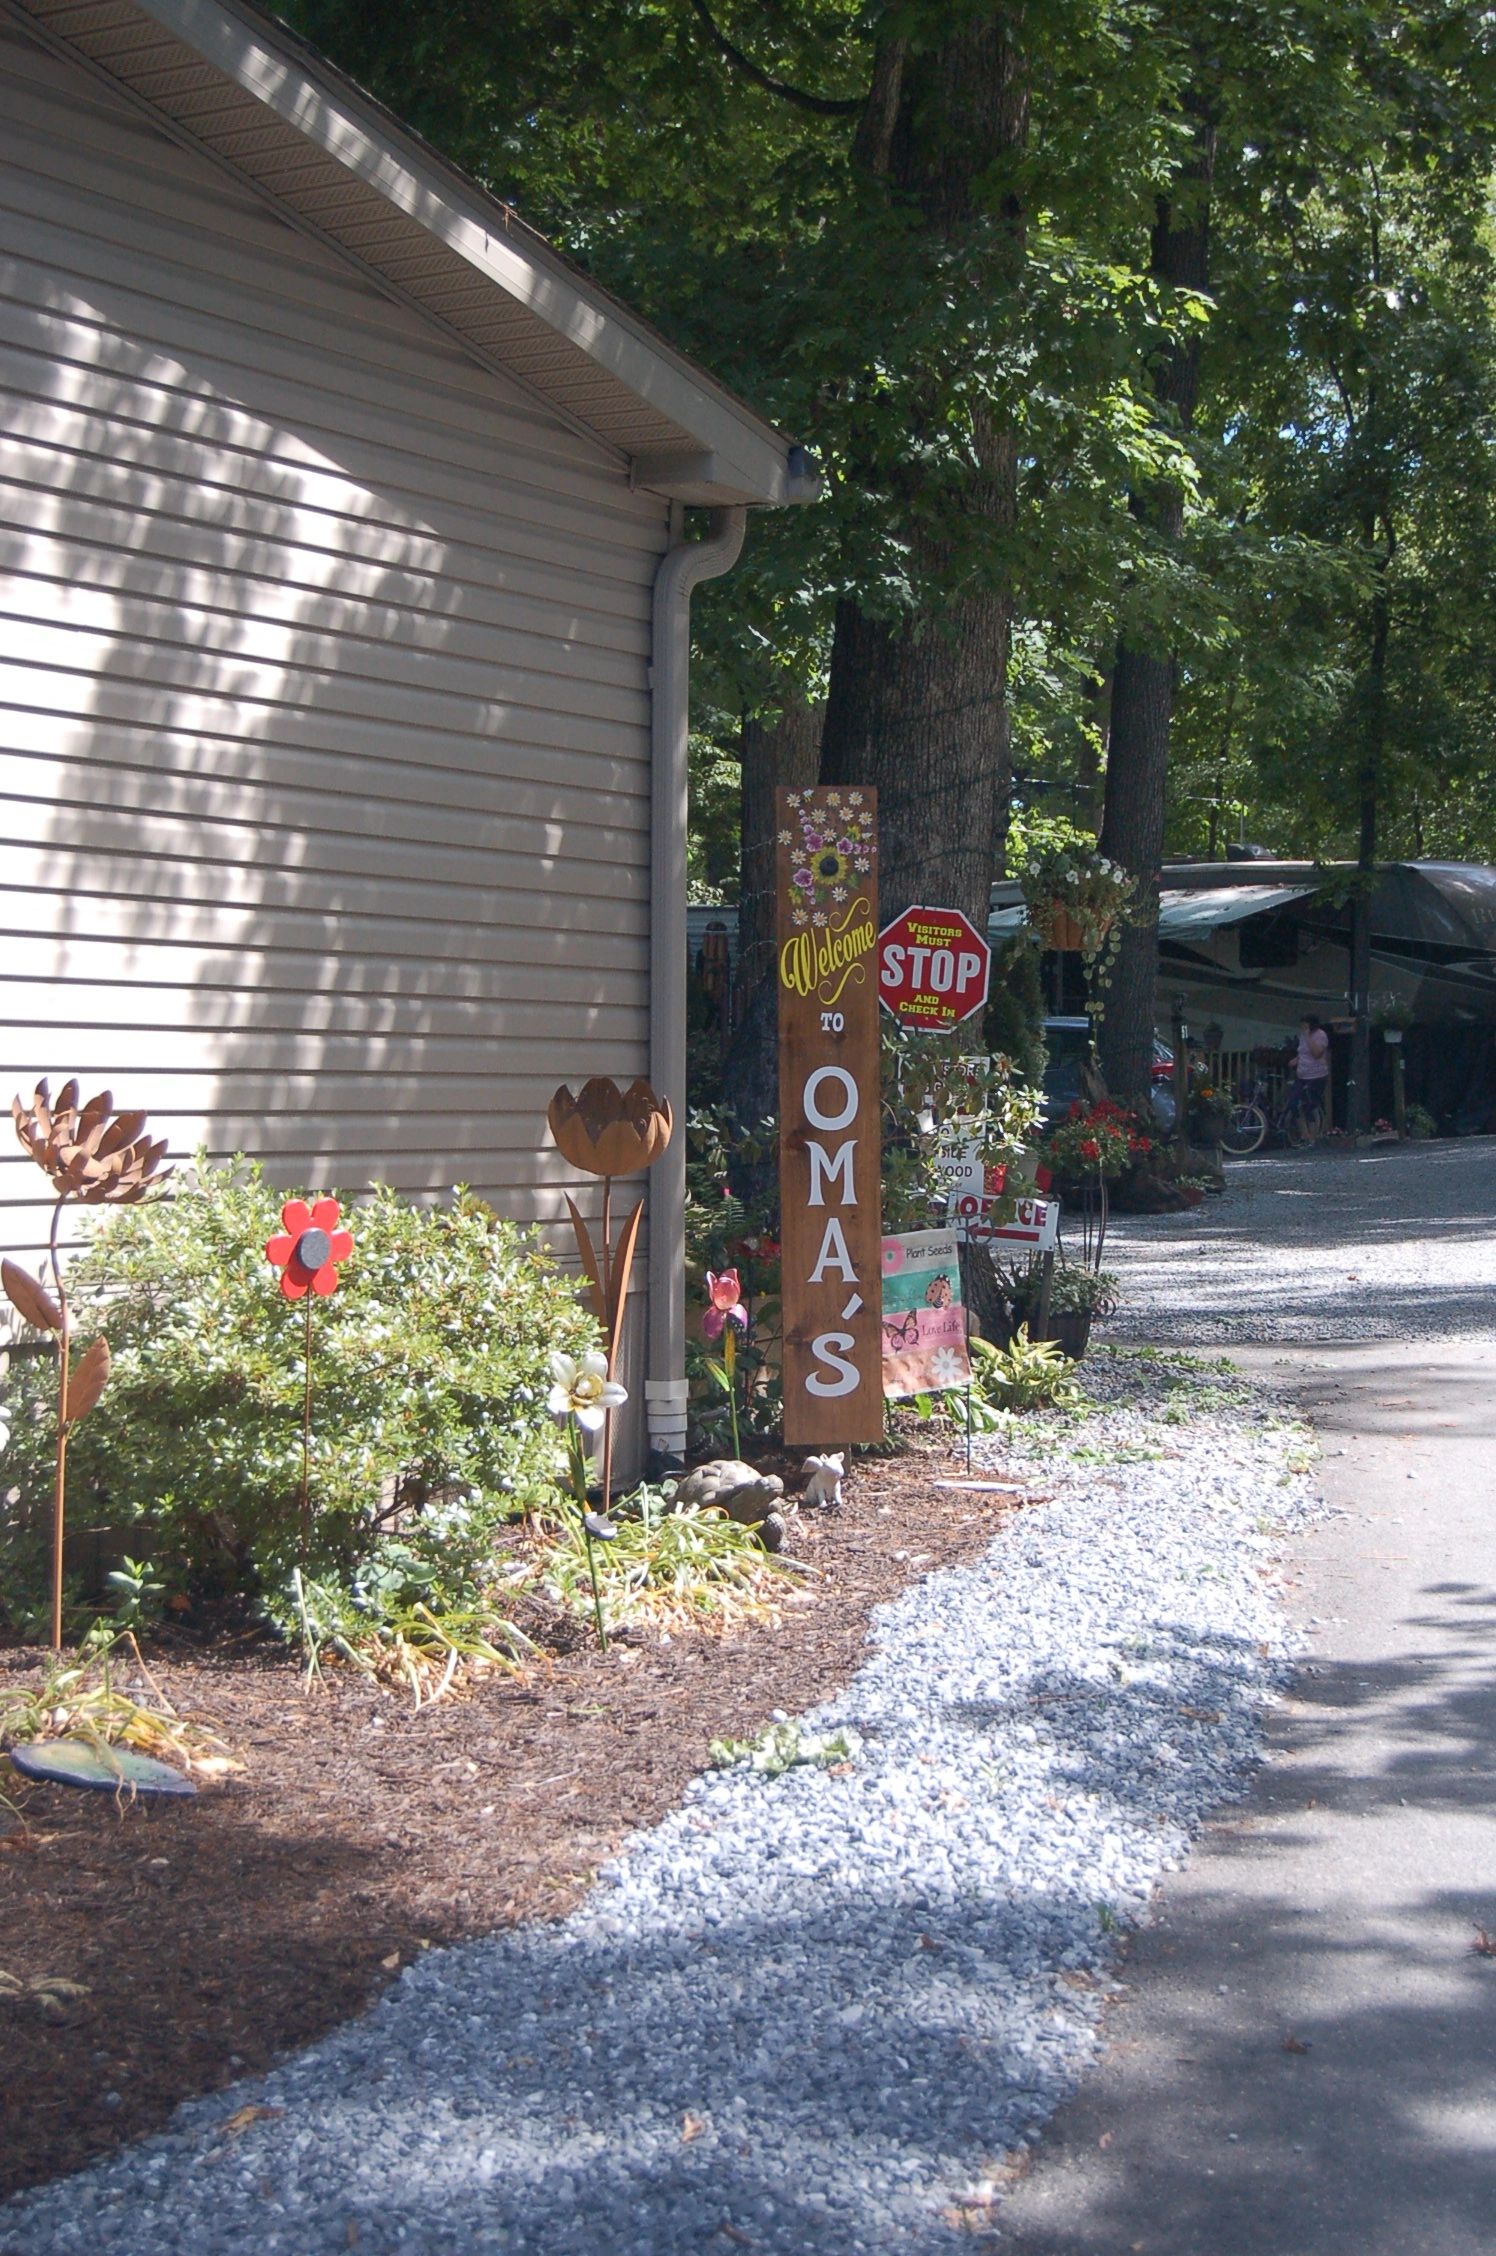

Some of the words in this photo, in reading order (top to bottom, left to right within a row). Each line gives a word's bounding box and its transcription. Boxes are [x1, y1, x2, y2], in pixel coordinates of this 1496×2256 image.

[780, 921, 877, 997] Welcome
[881, 944, 981, 994] STOP
[914, 994, 940, 1006] AND
[820, 1012, 845, 1032] TO
[959, 1195, 1048, 1227] OFCE
[906, 1247, 926, 1259] Plant
[928, 1244, 953, 1257] Seeds
